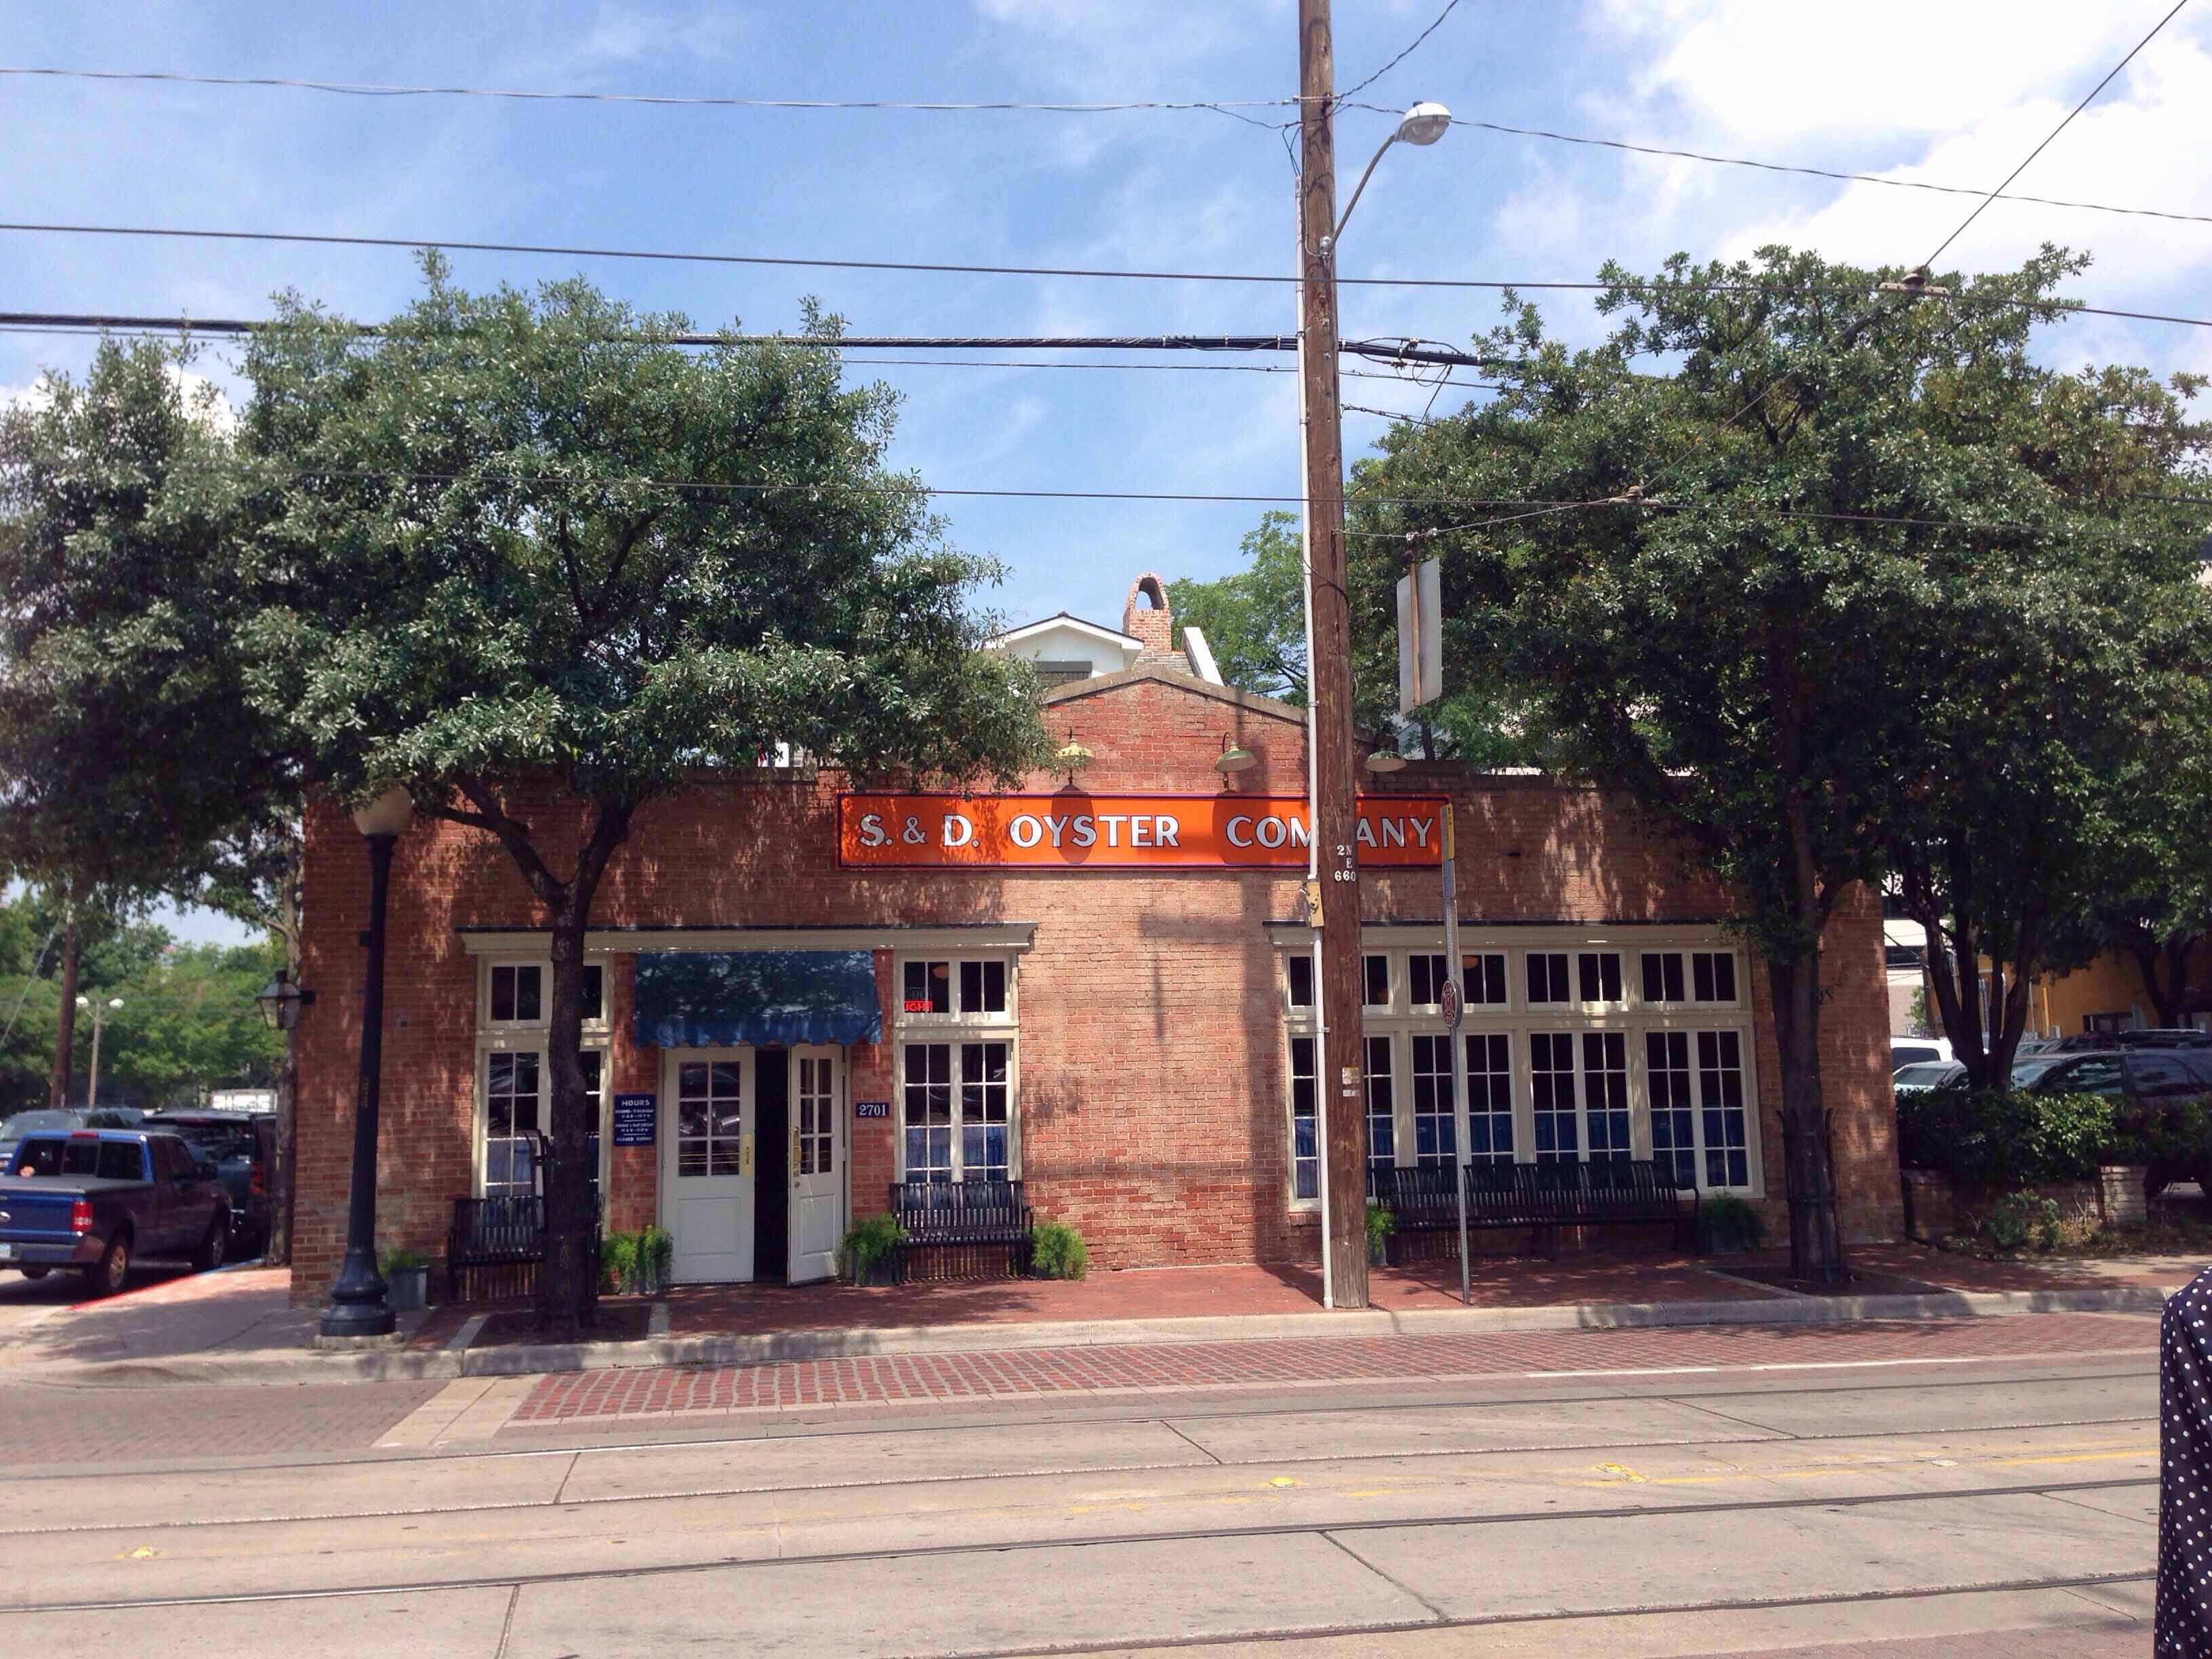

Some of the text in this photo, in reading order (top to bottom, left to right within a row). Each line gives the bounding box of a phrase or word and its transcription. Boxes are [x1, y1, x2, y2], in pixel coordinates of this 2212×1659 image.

[859, 814, 893, 847] S.
[902, 816, 928, 845] &
[943, 814, 980, 847] D.
[1008, 814, 1181, 848] OYSTER
[1225, 815, 1434, 848] COMANY
[1334, 870, 1356, 882] 660
[859, 1104, 886, 1117] 2701
